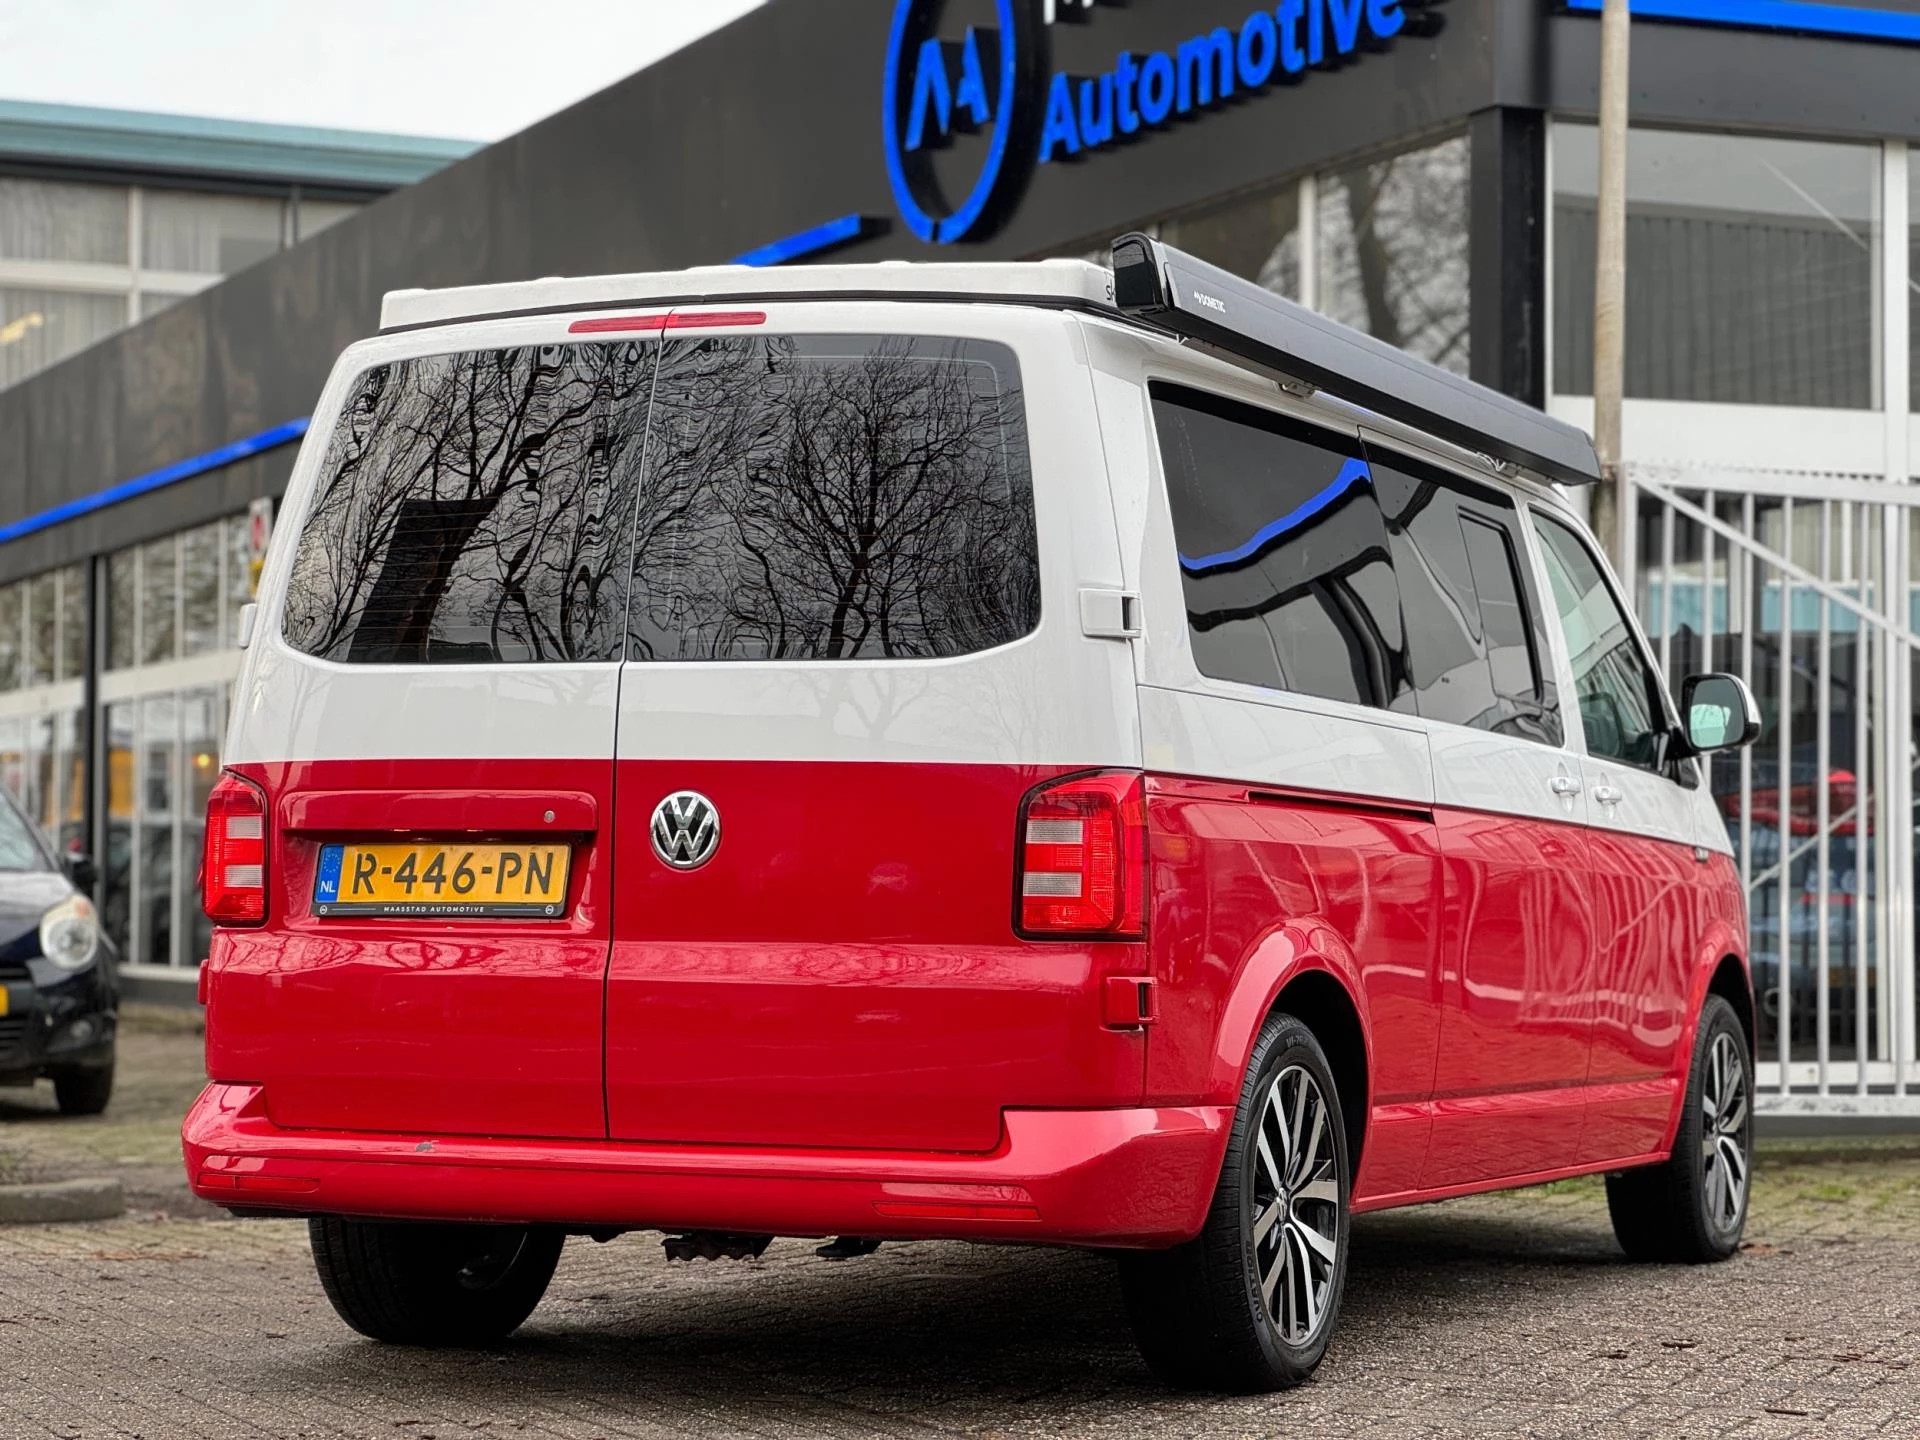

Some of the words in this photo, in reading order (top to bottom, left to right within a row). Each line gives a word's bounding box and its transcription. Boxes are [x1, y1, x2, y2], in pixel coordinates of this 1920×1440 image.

[1039, 0, 1407, 164] Automotive
[320, 879, 336, 893] NL
[351, 851, 554, 895] R-446-PN
[383, 905, 427, 913] MAASSTAD
[430, 905, 484, 913] AUTOMOTIVE
